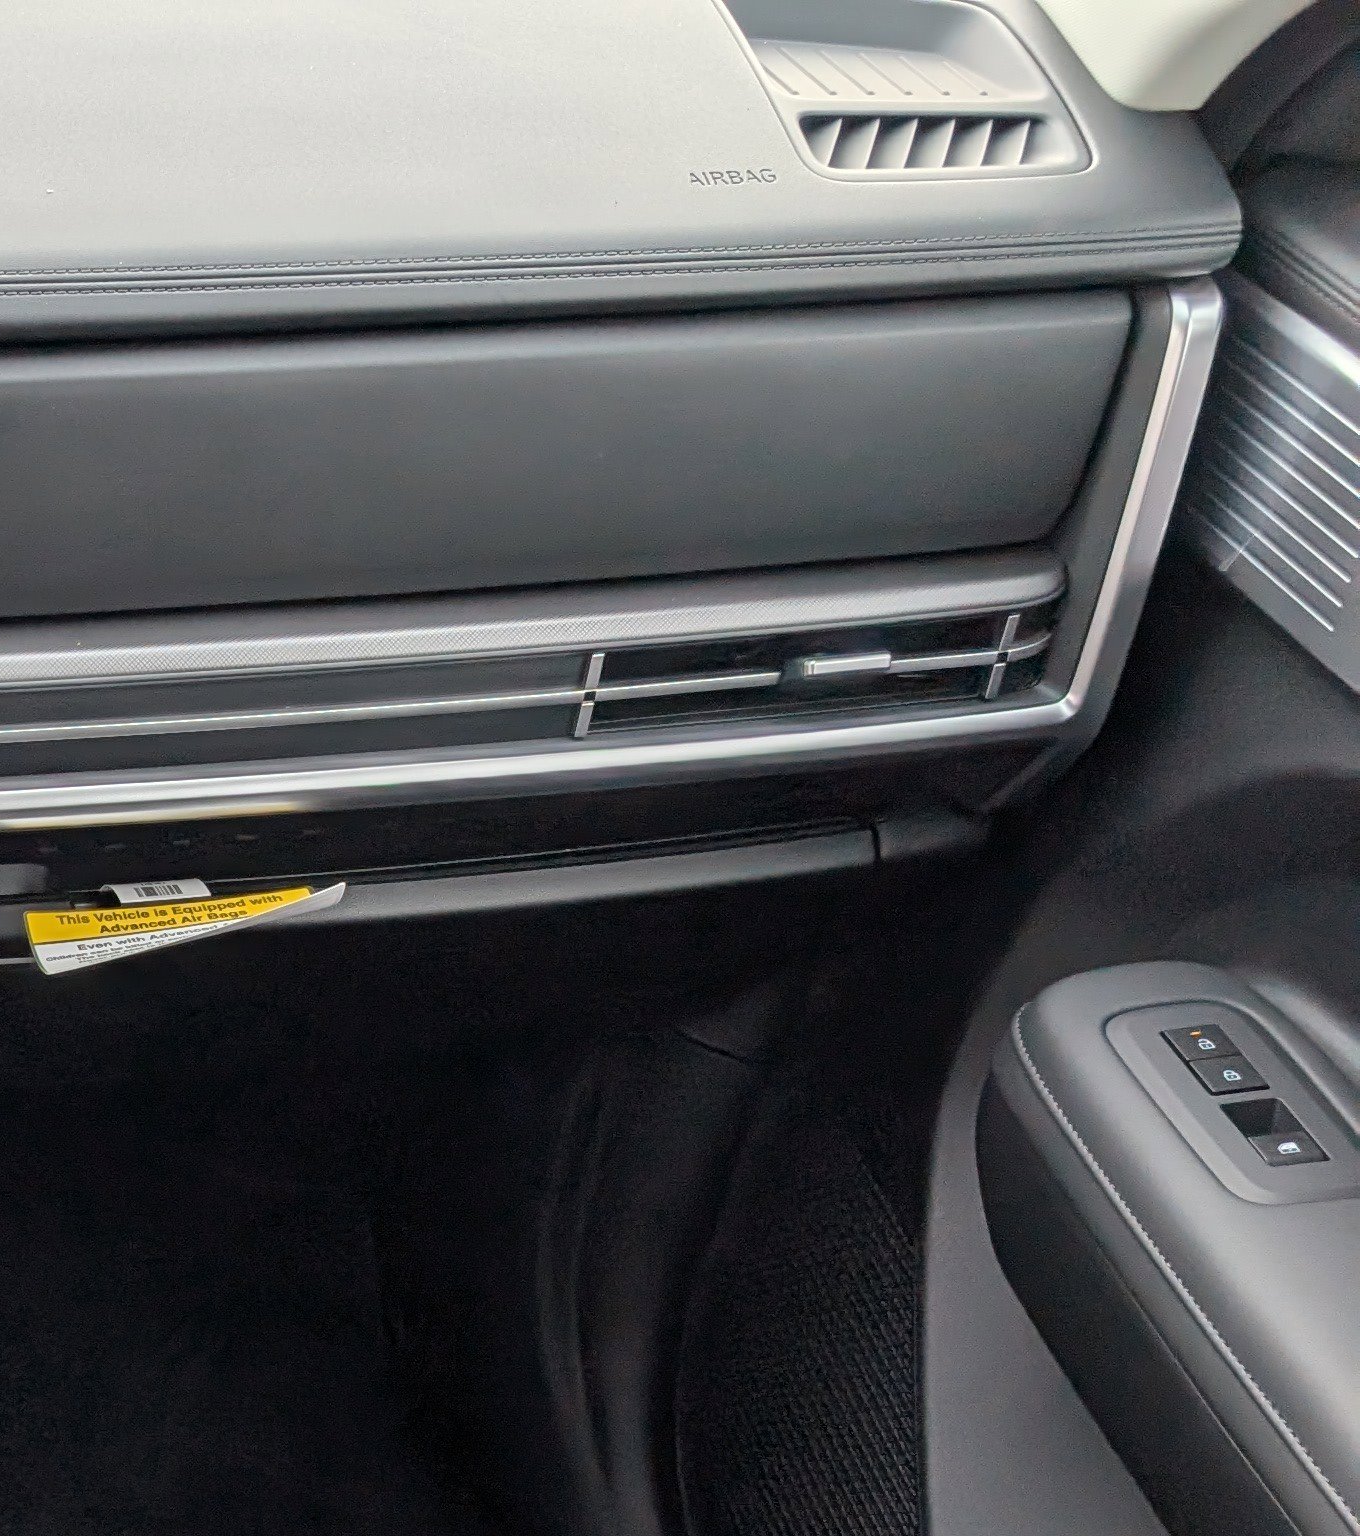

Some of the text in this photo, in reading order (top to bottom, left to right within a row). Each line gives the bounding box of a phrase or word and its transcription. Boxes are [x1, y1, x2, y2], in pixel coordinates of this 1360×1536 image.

[689, 168, 777, 186] AIRBAG
[56, 894, 283, 926] This Vehicle is Equipped with
[100, 908, 248, 934] Advanced Air Bags
[77, 941, 113, 951] Even
[116, 936, 145, 945] with
